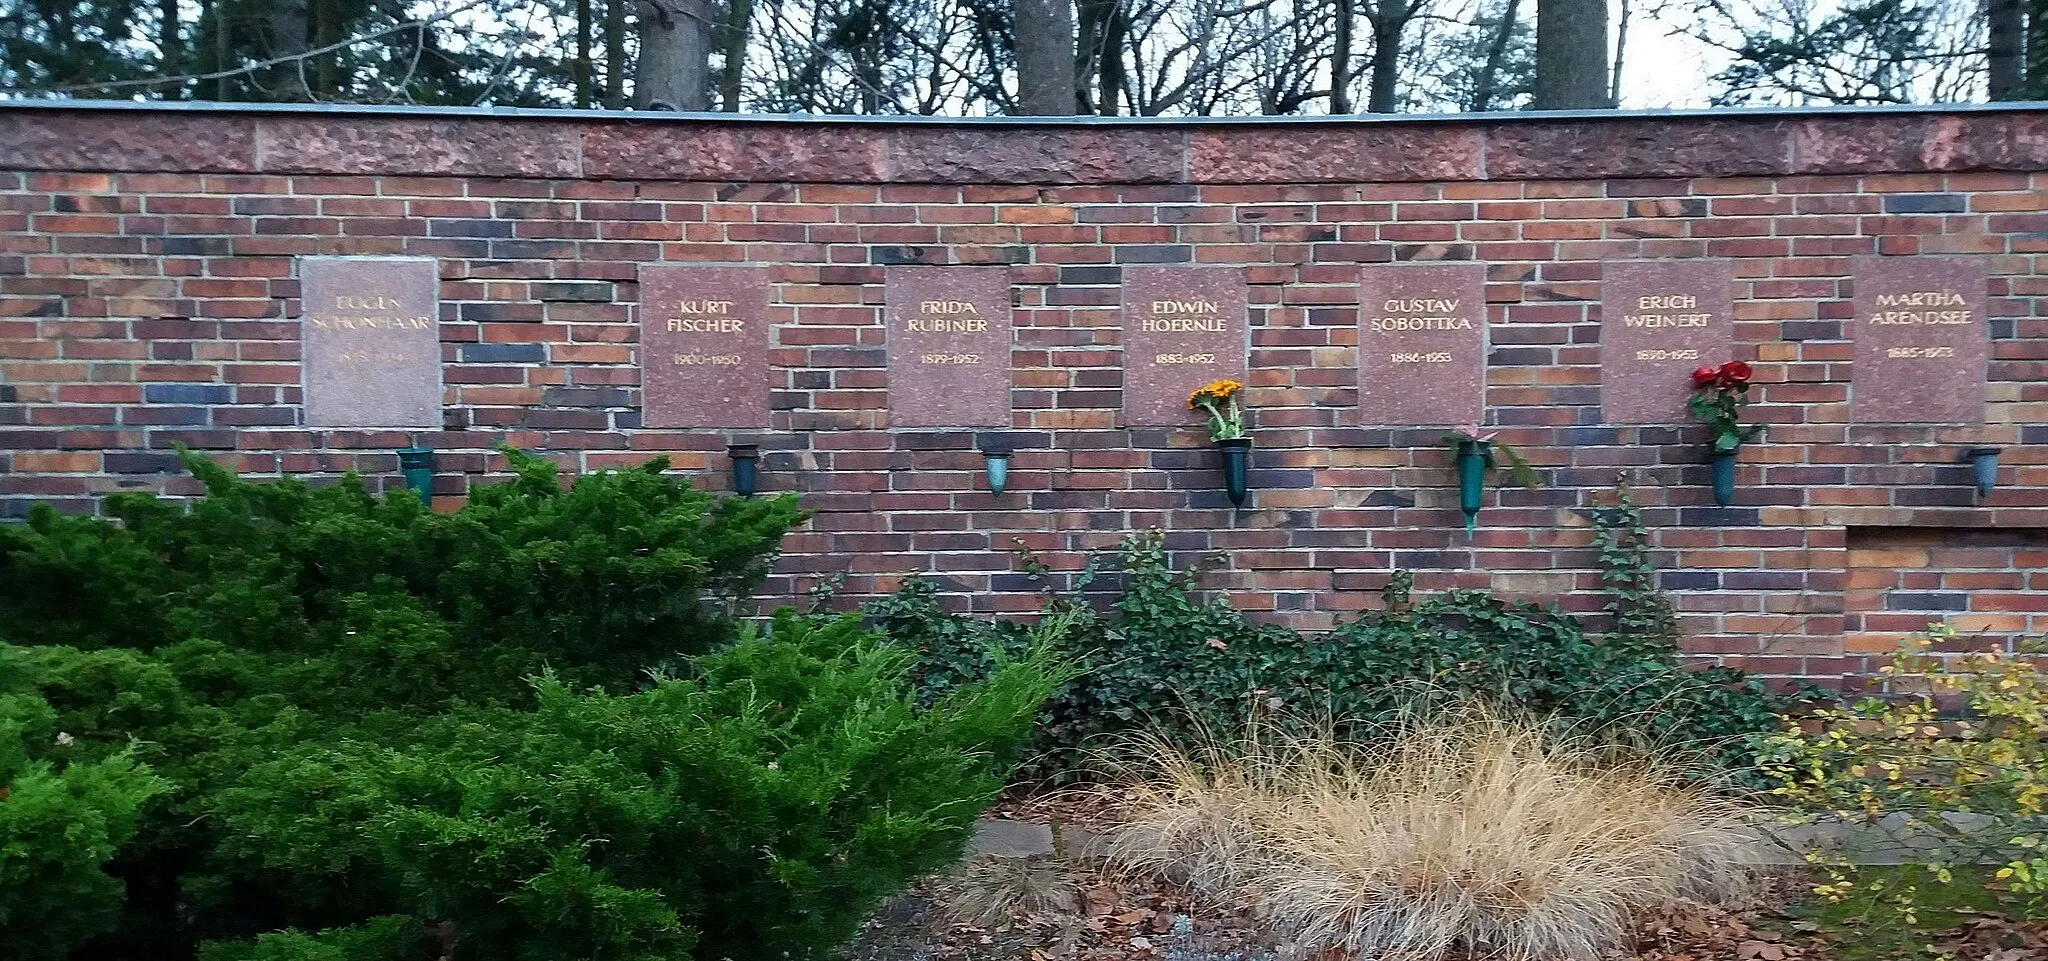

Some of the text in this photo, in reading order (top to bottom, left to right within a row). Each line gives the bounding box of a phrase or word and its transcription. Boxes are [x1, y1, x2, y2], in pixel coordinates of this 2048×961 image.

[1639, 295, 1696, 309] ERICH
[1875, 292, 1966, 306] MARTHA
[680, 300, 734, 314] KURT
[920, 301, 977, 314] FRIDA
[1153, 301, 1218, 314] EDWIN
[1384, 299, 1460, 313] GUSTAV
[1370, 317, 1472, 331] SOBOTTKA
[1624, 313, 1713, 328] WEINERT
[1868, 310, 1973, 325] ARENDSEE
[667, 319, 745, 332] FISCHER
[907, 319, 988, 332] RUBINER
[1142, 319, 1227, 332] HOERNLE
[674, 353, 741, 365] 1900-1950
[921, 354, 980, 364] 1879-1952
[1156, 353, 1216, 364] 1883-1952
[1391, 352, 1453, 363] 1886-1953
[1636, 349, 1699, 360] 1890-1953
